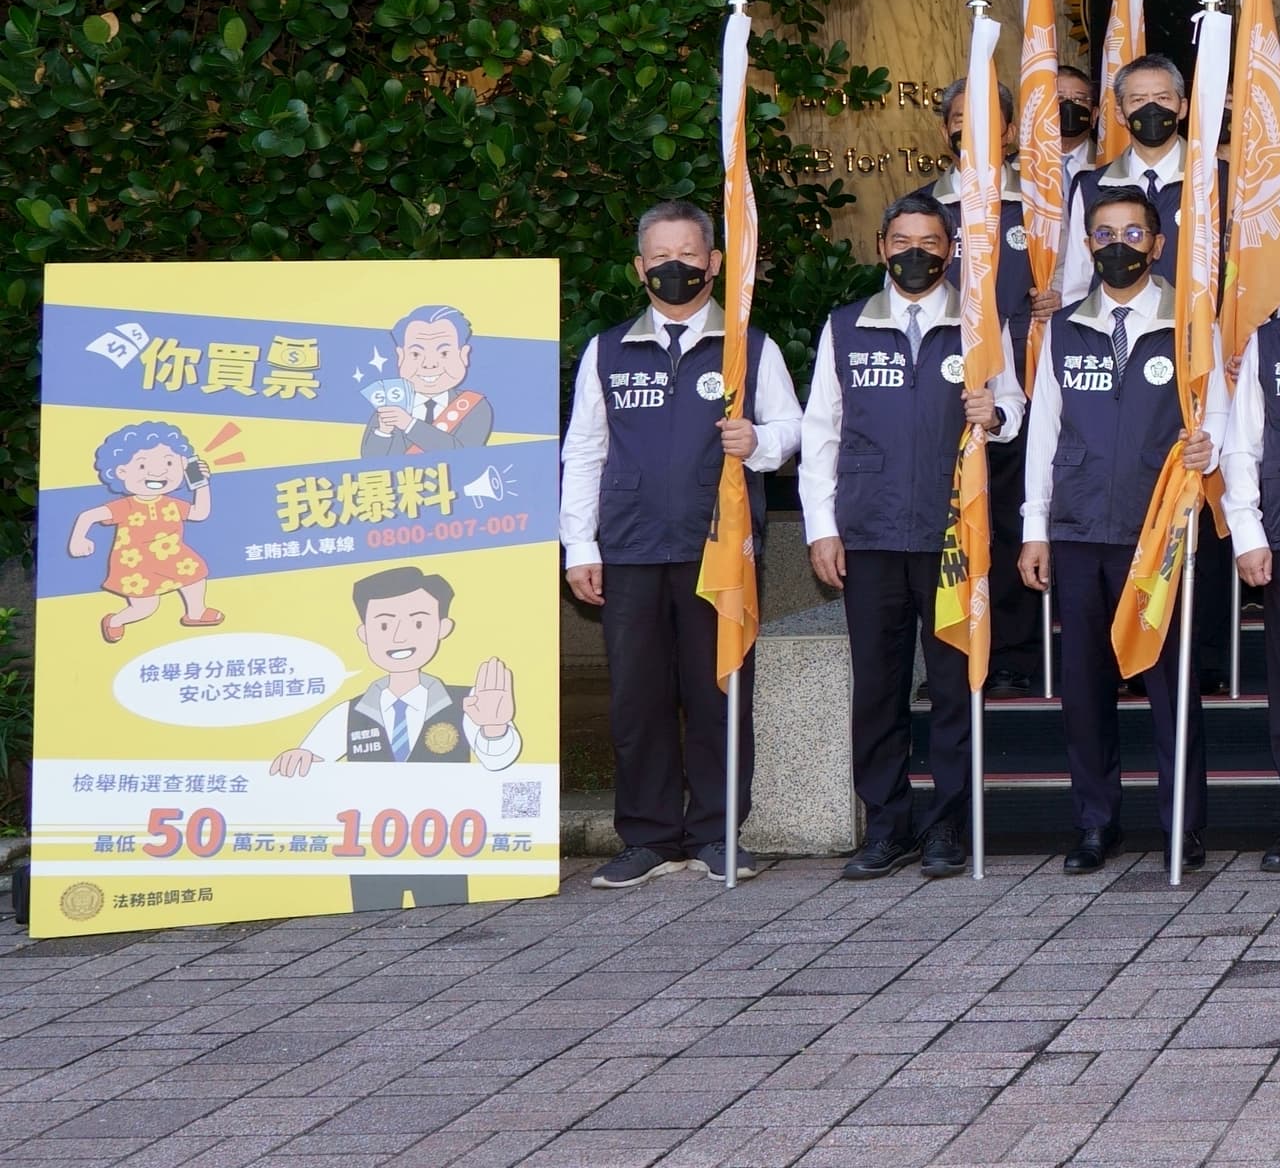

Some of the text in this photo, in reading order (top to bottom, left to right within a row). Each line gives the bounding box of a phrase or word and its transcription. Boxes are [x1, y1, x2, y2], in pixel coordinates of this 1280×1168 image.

[140, 336, 321, 400] 你買票
[848, 351, 905, 366] 調查局
[1064, 355, 1114, 371] 調查局
[609, 372, 668, 387] 調查局
[852, 368, 904, 387] MJIB
[1063, 370, 1112, 391] MJIB
[613, 389, 664, 409] MJIB
[276, 463, 458, 532] 我爆料
[245, 513, 529, 562] 查賄達人專線 0800-007-007
[179, 676, 326, 703] 安心交給調查局
[353, 741, 382, 755] MJIB
[93, 834, 136, 853] 最低
[142, 807, 226, 858] 50
[332, 808, 488, 858] 1000
[491, 833, 532, 853] 萬元
[112, 887, 214, 910] 法務部調查局
